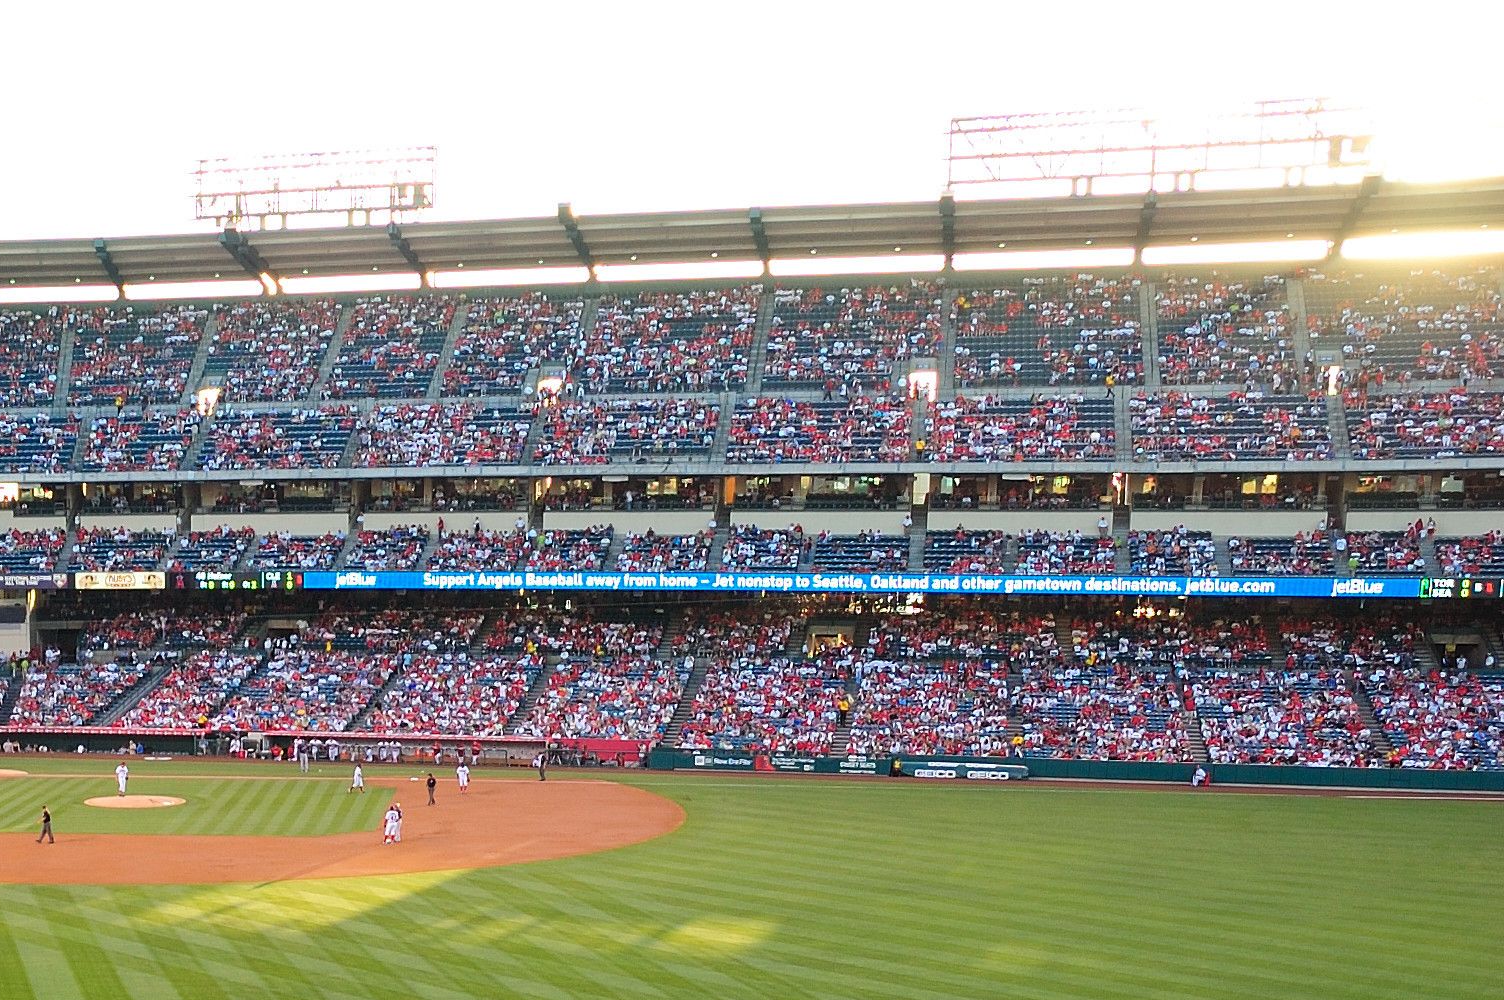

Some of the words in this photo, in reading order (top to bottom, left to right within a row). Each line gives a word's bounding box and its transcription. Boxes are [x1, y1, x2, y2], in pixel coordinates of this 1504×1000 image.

[423, 573, 475, 588] Support
[478, 573, 523, 589] Angels
[525, 573, 583, 586] Baseball
[586, 576, 621, 590] away
[623, 573, 656, 587] from
[659, 573, 697, 587] home
[712, 574, 734, 587] Jet
[737, 574, 793, 591] nonstop
[795, 575, 809, 588] to
[813, 574, 867, 591] Seattle,
[870, 575, 930, 589] Oakland
[931, 575, 959, 590] and
[962, 575, 1002, 590] other
[1004, 578, 1082, 594] gametown
[1085, 578, 1181, 592] destinations.
[1184, 577, 1275, 596] jetblue.com
[1331, 579, 1385, 598] jetBlue
[914, 768, 957, 779] GEICO
[966, 770, 1010, 780] GEICO
